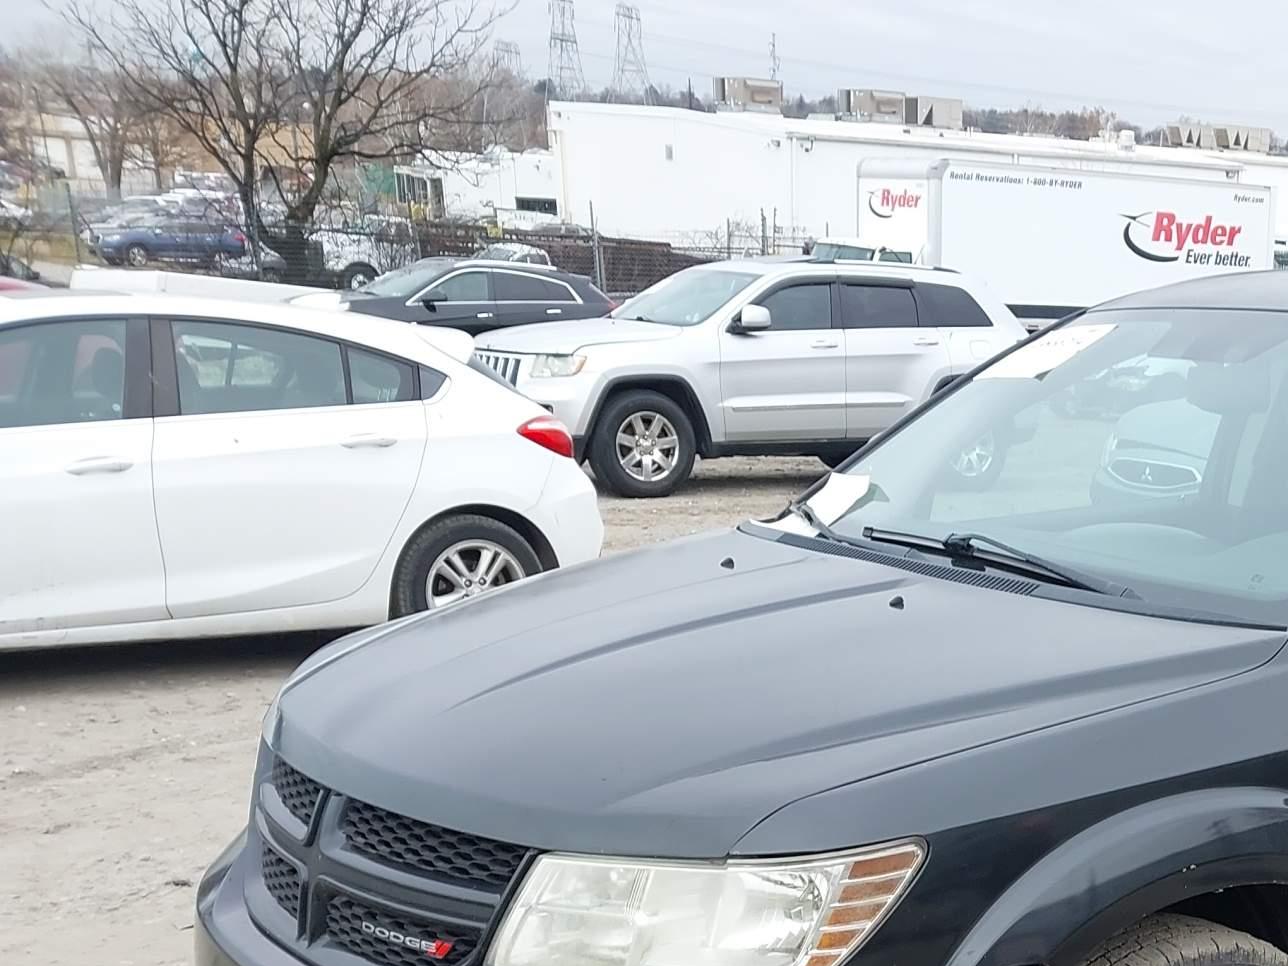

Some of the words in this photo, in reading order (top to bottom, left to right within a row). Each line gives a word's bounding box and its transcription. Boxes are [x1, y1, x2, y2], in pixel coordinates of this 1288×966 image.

[949, 170, 974, 181] Rental
[975, 172, 1024, 185] Reservations:
[880, 188, 922, 212] Ryder
[1151, 211, 1242, 251] Ryder
[1185, 249, 1213, 265] Ever
[1214, 251, 1251, 267] better.
[362, 920, 437, 954] DODGE
